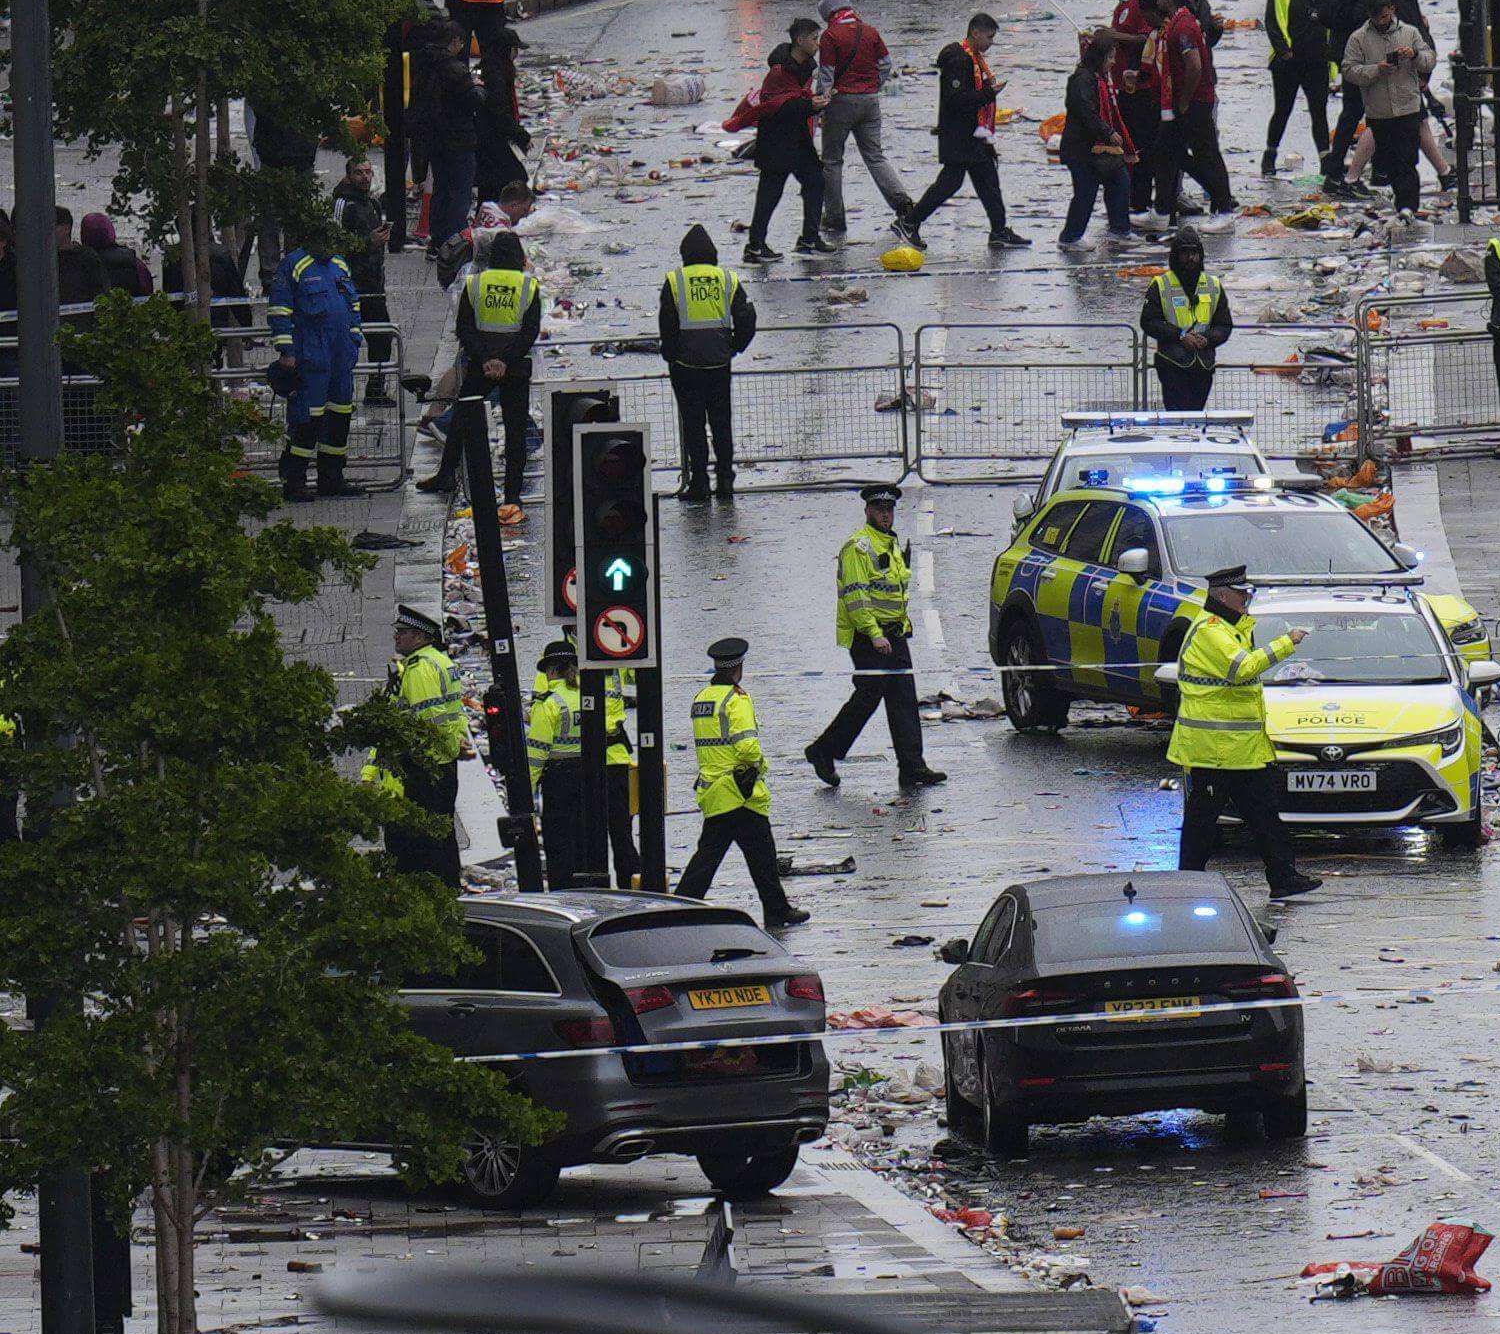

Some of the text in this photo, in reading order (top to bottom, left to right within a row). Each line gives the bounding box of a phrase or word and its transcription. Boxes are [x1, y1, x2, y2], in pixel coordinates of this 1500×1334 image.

[1297, 715, 1366, 726] POLICE
[1294, 773, 1371, 789] MV74 VRO
[696, 988, 765, 1007] YK70 NDE
